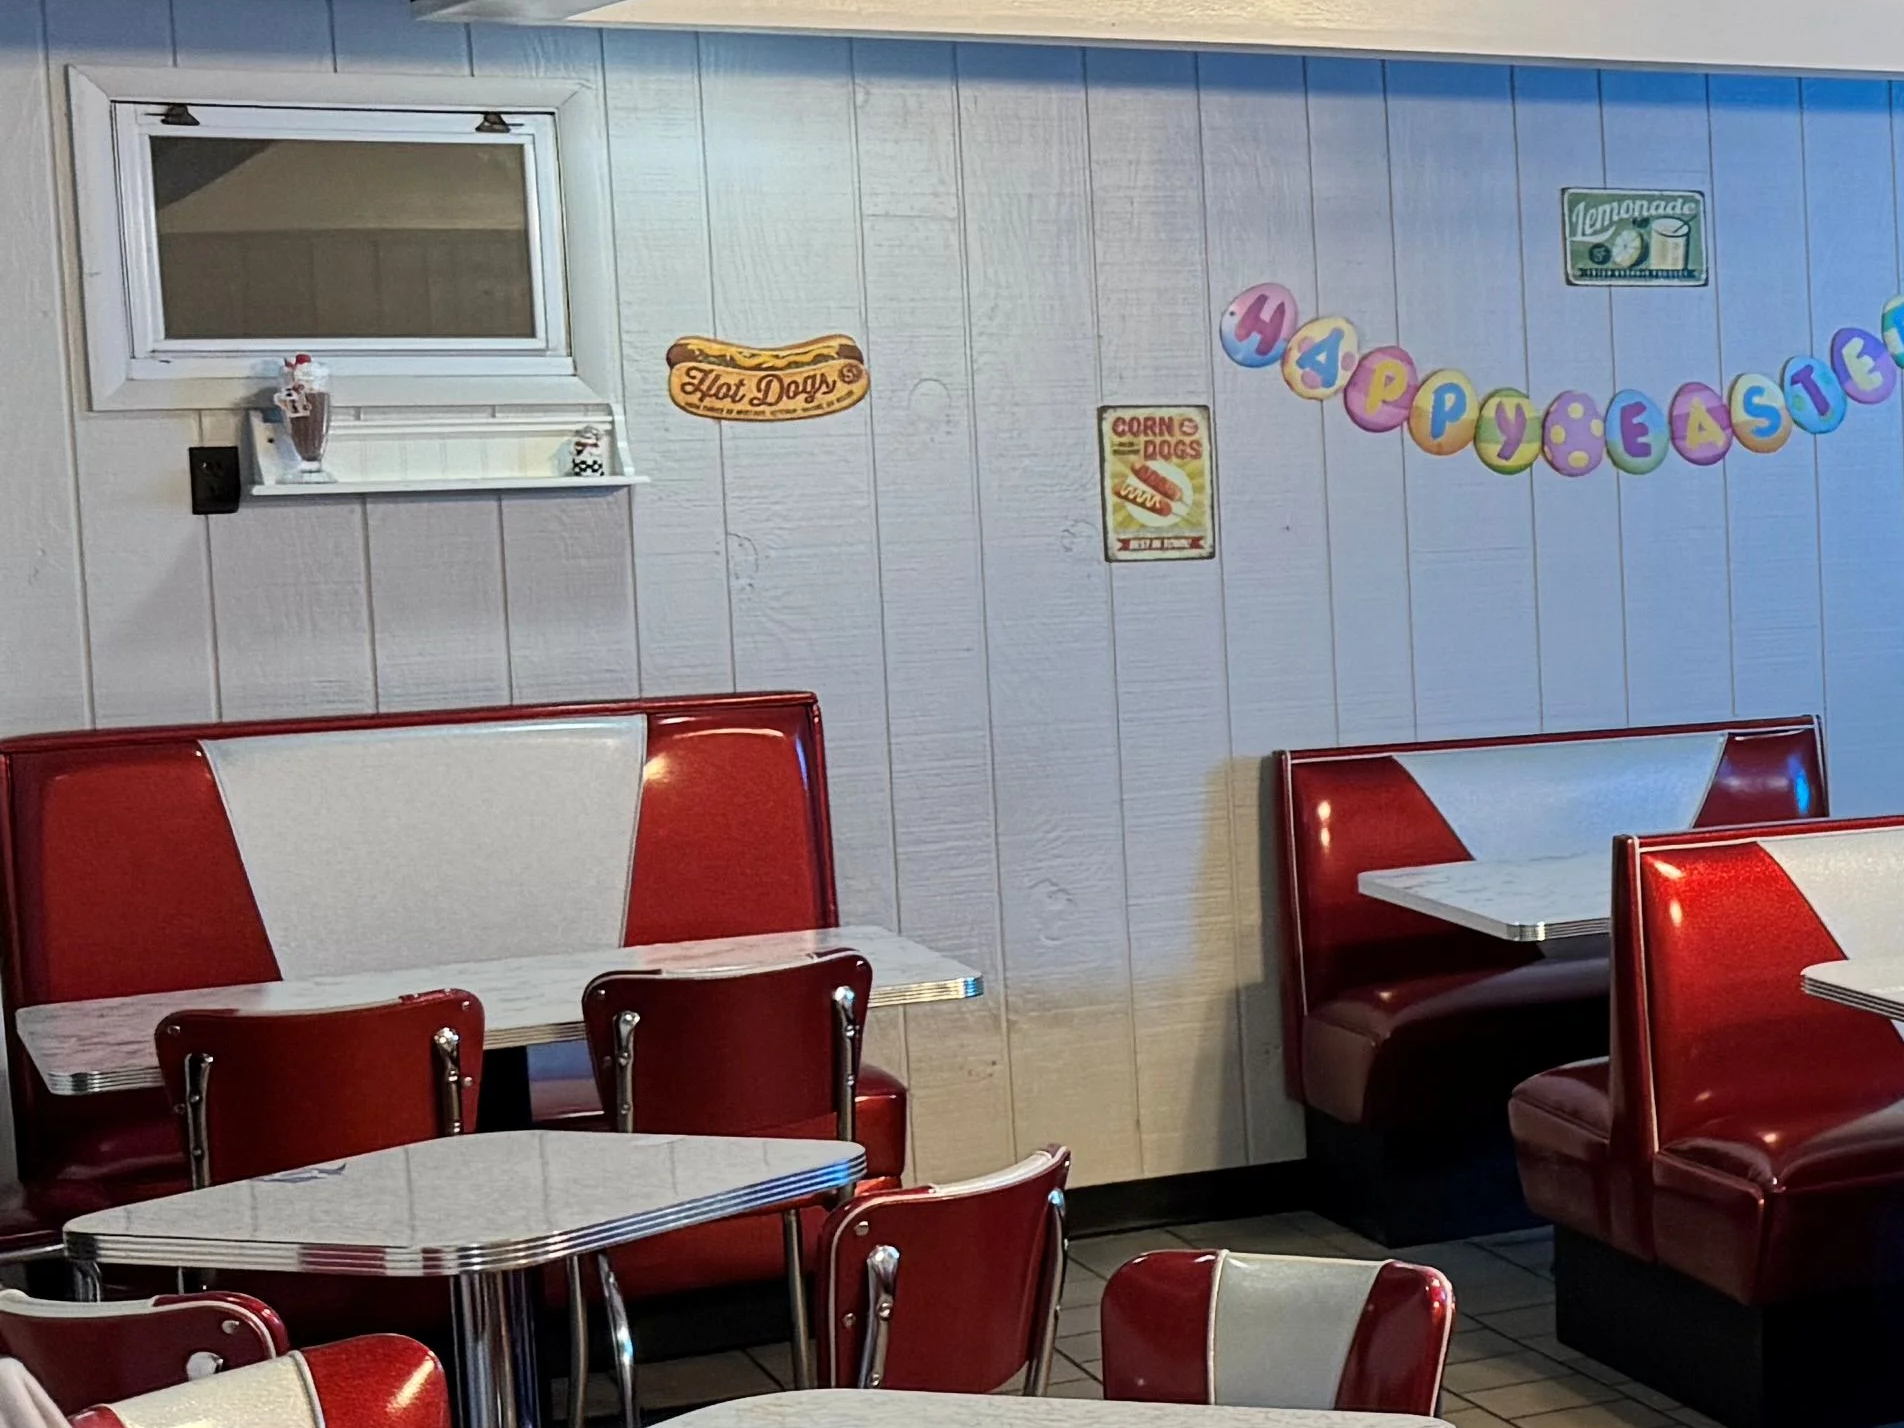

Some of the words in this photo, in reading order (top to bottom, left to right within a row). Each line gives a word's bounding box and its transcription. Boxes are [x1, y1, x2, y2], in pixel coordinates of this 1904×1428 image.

[1570, 198, 1697, 241] Lemonade
[680, 366, 747, 404] Hot
[749, 373, 837, 408] Dogs
[1235, 293, 1531, 463] HAPPY
[1112, 416, 1175, 438] CORN
[1144, 439, 1203, 461] DOGS
